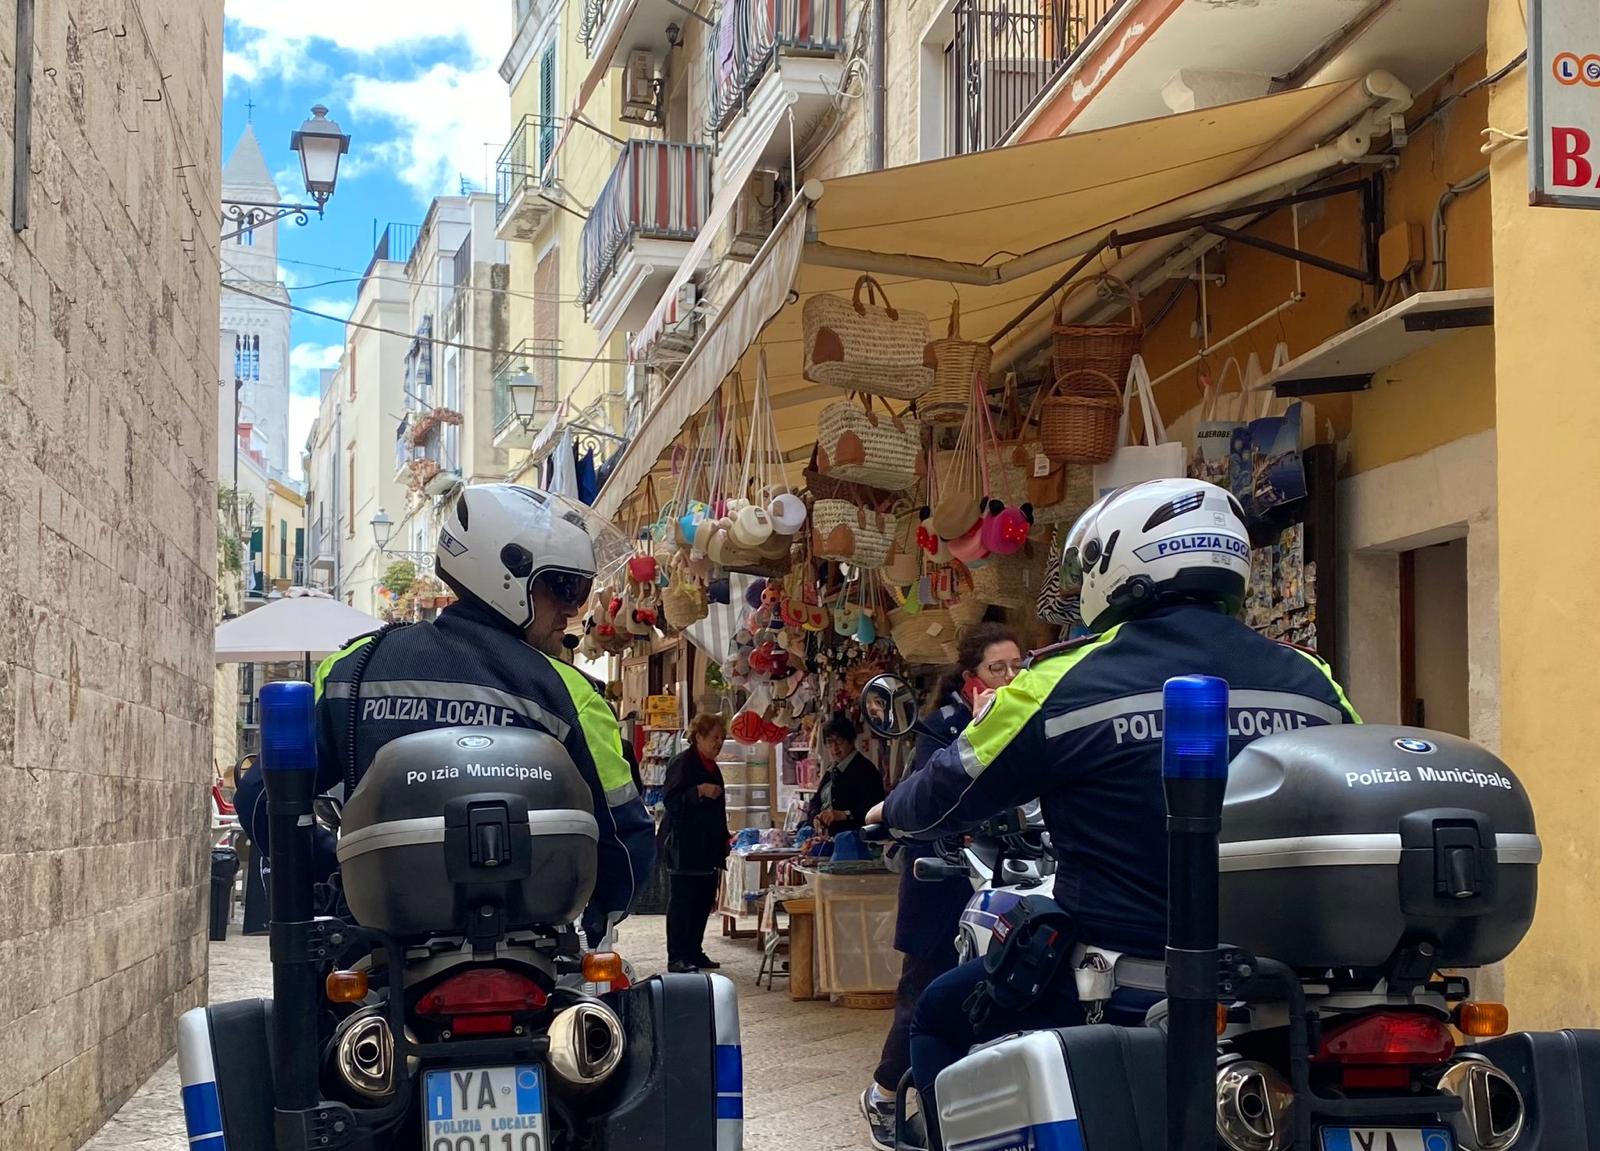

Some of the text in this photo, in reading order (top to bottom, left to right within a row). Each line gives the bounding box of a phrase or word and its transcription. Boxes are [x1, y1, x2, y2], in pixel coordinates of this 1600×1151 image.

[1157, 536, 1222, 555] POLIZIA
[362, 698, 514, 727] POLIZIA LOCALE
[466, 763, 553, 782] Municipale
[1345, 766, 1512, 790] Polizia Municipale
[454, 1070, 497, 1111] YA
[434, 1115, 537, 1135] POLIZIA LOCALE
